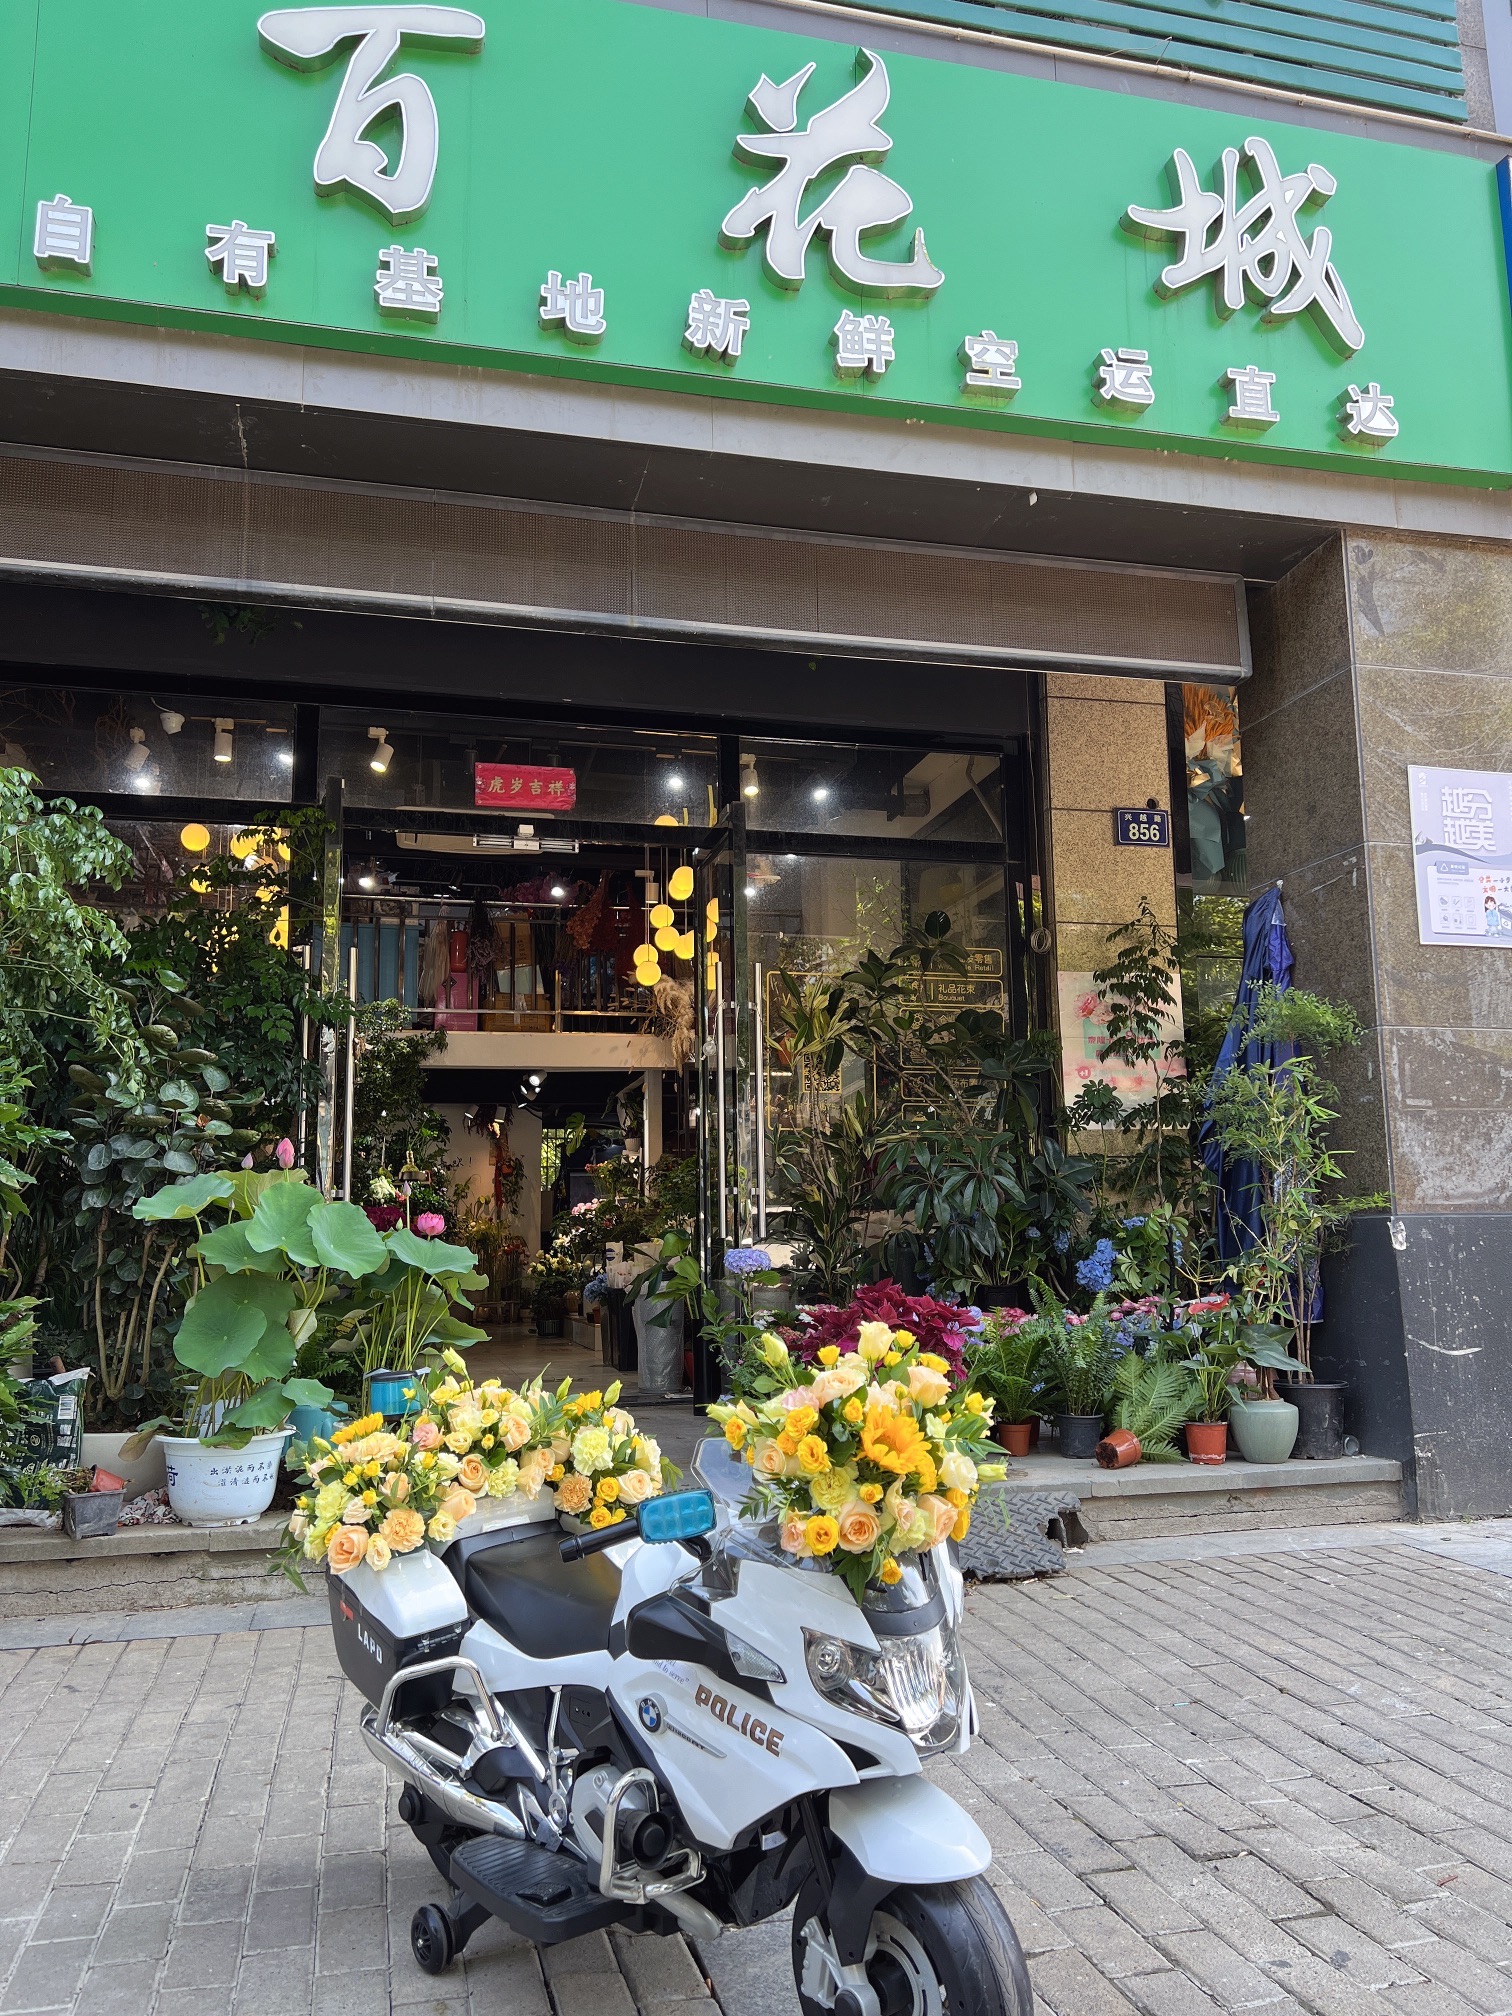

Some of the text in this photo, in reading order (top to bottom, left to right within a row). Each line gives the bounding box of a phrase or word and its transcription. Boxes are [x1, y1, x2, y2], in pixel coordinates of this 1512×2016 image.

[257, 5, 1365, 352] 百花城
[34, 194, 1399, 438] 自有基地新鲜空运直达
[487, 776, 565, 796] 虎岁吉祥
[1124, 813, 1162, 823] 兴越路
[1129, 823, 1160, 841] 856
[938, 984, 976, 994] 礼品花束
[938, 994, 966, 1002] Bouquet
[357, 1623, 383, 1665] LAPD
[694, 1683, 785, 1758] POLICE
